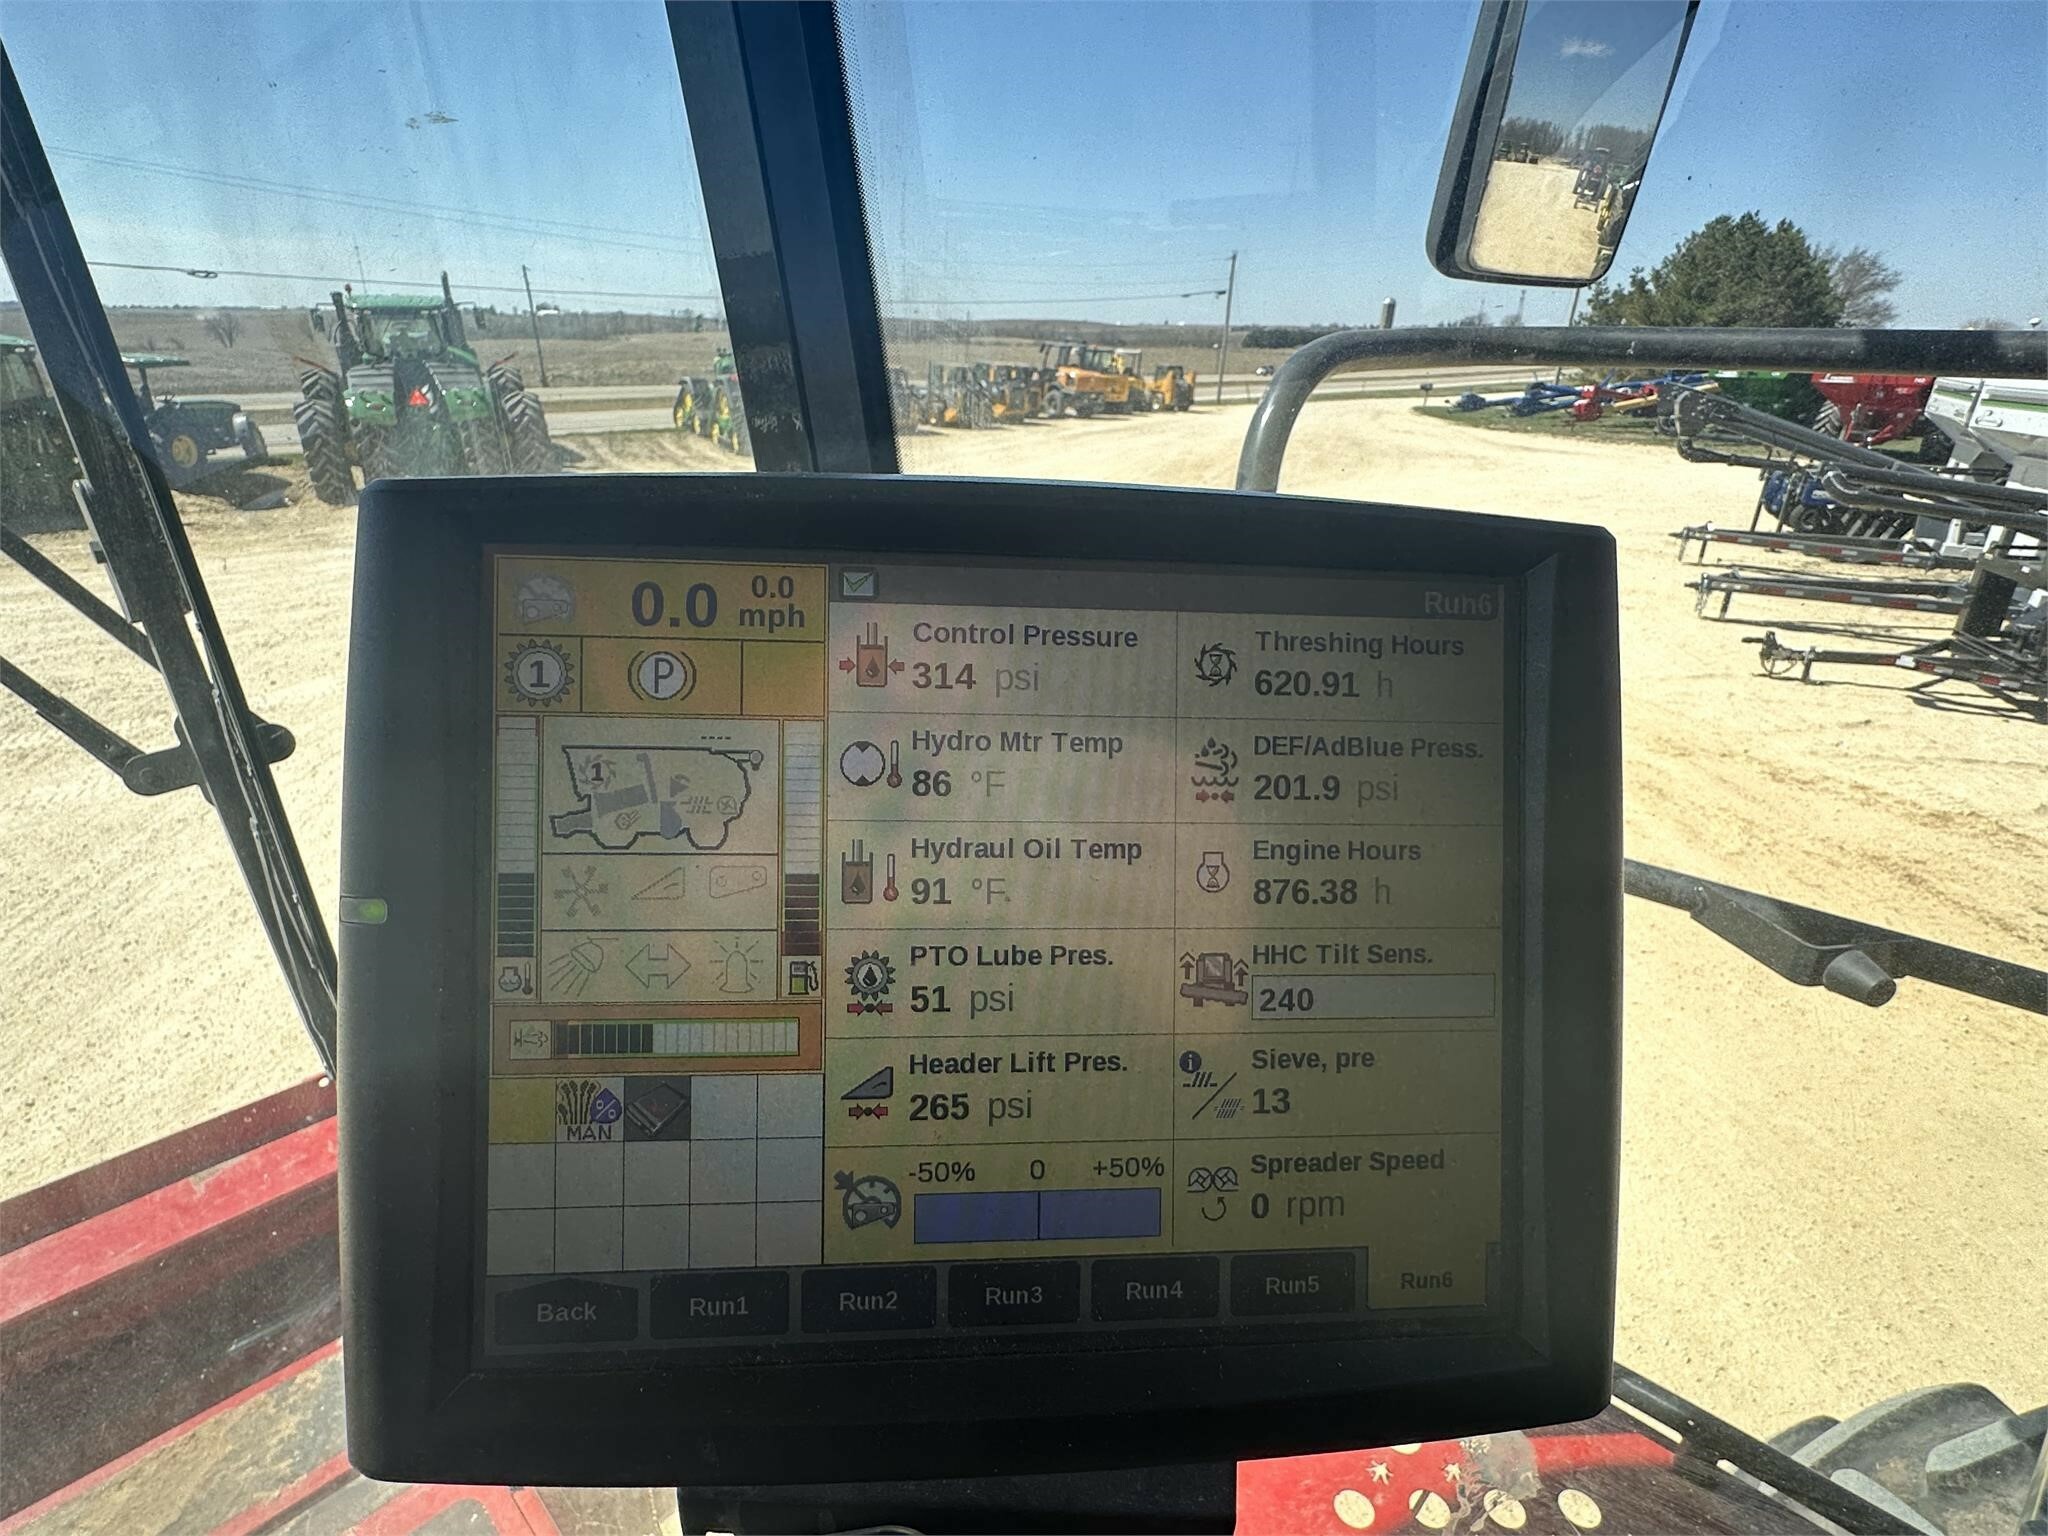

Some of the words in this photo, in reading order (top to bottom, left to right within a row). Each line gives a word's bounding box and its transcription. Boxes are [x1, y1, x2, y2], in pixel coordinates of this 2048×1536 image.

[751, 575, 794, 598] 0.0
[631, 581, 718, 628] 0.0
[1424, 591, 1492, 615] Run6
[739, 604, 805, 633] mph
[913, 622, 1014, 644] Control
[1024, 625, 1138, 647] Pressure
[1255, 631, 1383, 659] Threshing
[1391, 635, 1464, 656] Hours
[529, 660, 549, 688] 1
[654, 658, 674, 693] P
[912, 662, 976, 690] 314
[995, 662, 1039, 698] psi
[1254, 670, 1360, 698] 620.91
[1377, 671, 1393, 698] h
[912, 730, 991, 756] Hydro
[1000, 732, 1043, 752] Mtr
[1051, 733, 1123, 759] Temp
[1254, 735, 1403, 757] DEF/AdBlue
[1411, 738, 1484, 759] Press.
[591, 763, 604, 781] 1
[912, 770, 951, 797] 86
[1254, 774, 1340, 801] 201.9
[1358, 773, 1399, 807] psi
[911, 837, 1014, 864] Hydraul
[1023, 839, 1060, 859] Oil
[1071, 839, 1142, 865] Temp
[1253, 840, 1340, 866] Engine
[1348, 841, 1422, 860] Hours
[912, 878, 951, 905] 91
[1253, 878, 1358, 905] 876.38
[1374, 877, 1391, 904] h
[910, 945, 968, 966] PTO
[977, 945, 1042, 966] Lube
[1050, 946, 1113, 965] Pres.
[1252, 944, 1307, 965] HHC
[1316, 944, 1359, 964] Tilt
[1367, 945, 1433, 964] Sens.
[910, 985, 950, 1013] 51
[970, 983, 1014, 1019] psi
[1259, 988, 1314, 1012] 240
[909, 1052, 1002, 1074] Header
[1010, 1052, 1056, 1073] Lift
[1064, 1052, 1128, 1072] Pres.
[1252, 1049, 1327, 1072] Sieve,
[1336, 1051, 1375, 1074] pre
[909, 1093, 969, 1120] 265
[988, 1090, 1032, 1126] psi
[1252, 1088, 1290, 1114] 13
[567, 1125, 612, 1141] MAN
[909, 1162, 975, 1183] -50%
[1030, 1160, 1045, 1180] 0
[1093, 1156, 1164, 1178] +50%
[1251, 1153, 1362, 1179] Spreader
[1369, 1149, 1445, 1176] Speed
[1251, 1192, 1269, 1219] 0
[1287, 1194, 1344, 1224] rpm
[1126, 1280, 1183, 1301] Run4
[1266, 1276, 1320, 1295] Run5
[1401, 1272, 1453, 1289] Run6
[690, 1296, 749, 1316] Run1
[839, 1291, 897, 1312] Run2
[985, 1286, 1043, 1306] Run3
[537, 1302, 596, 1323] Back
